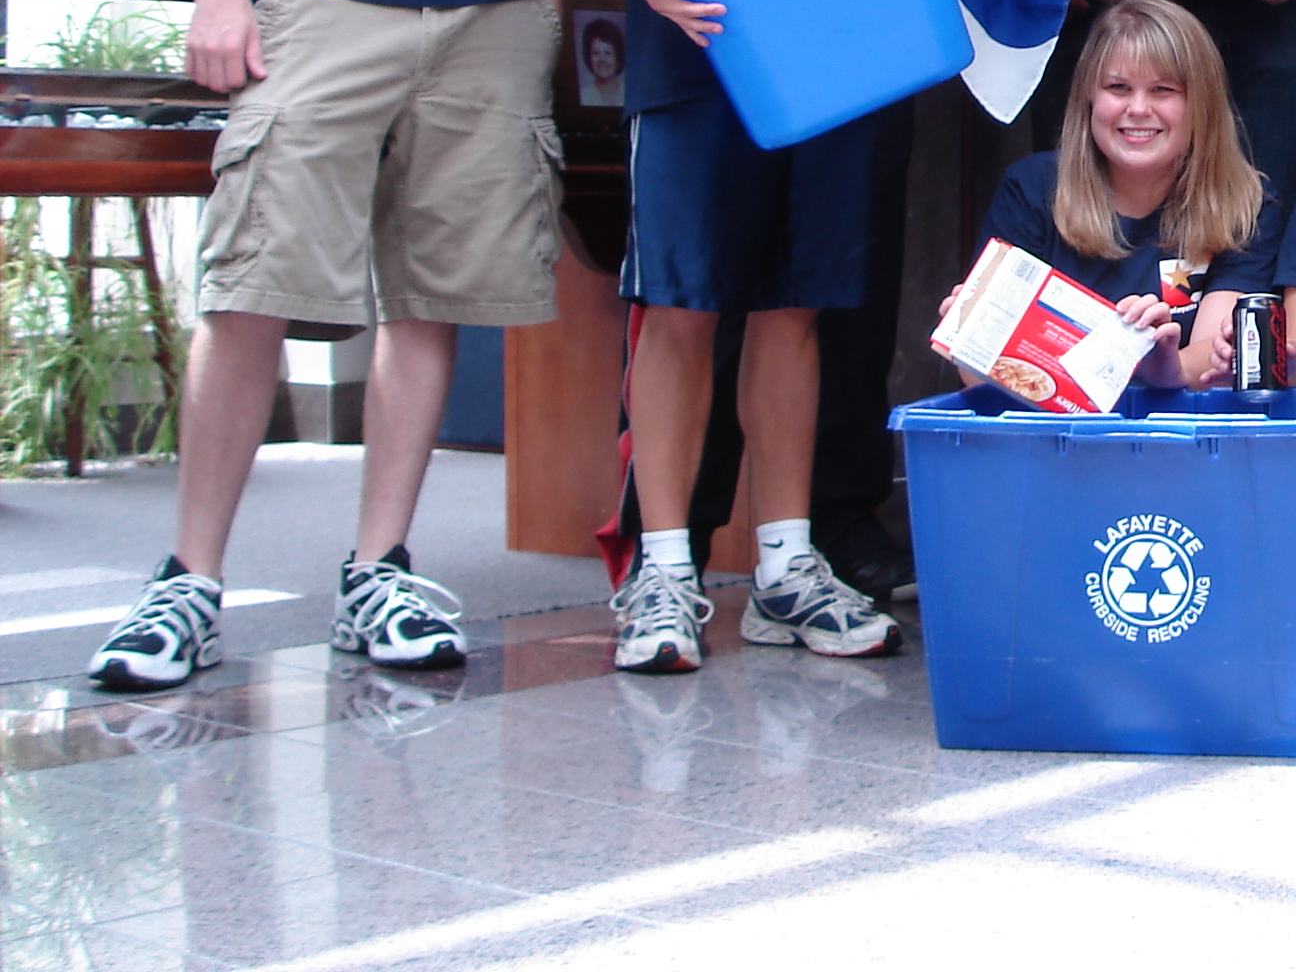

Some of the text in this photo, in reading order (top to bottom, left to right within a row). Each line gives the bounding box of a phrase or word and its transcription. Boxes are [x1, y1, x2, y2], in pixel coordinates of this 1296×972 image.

[1093, 514, 1204, 557] LAFAYETTE
[1085, 572, 1211, 643] CURBSIDE RECYCLING
